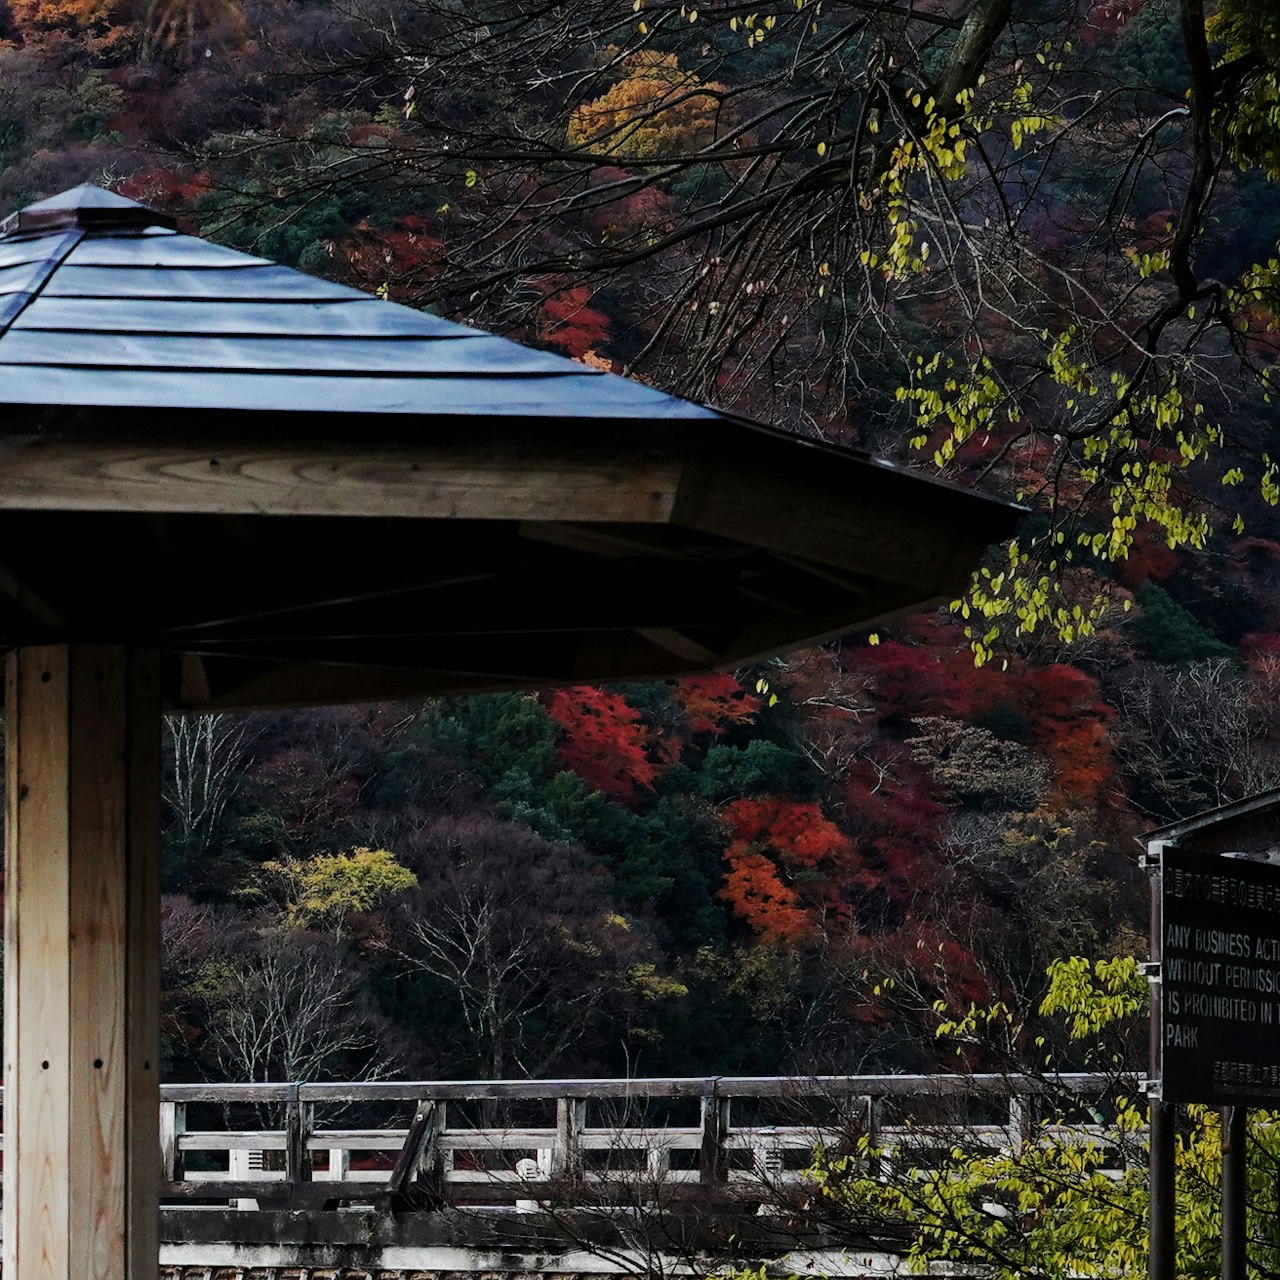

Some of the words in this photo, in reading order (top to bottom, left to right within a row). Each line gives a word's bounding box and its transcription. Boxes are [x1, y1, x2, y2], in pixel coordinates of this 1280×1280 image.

[1166, 923, 1190, 949] ANY
[1195, 928, 1251, 958] BUSINESS
[1166, 957, 1221, 986] WITHOUT
[1168, 990, 1180, 1015] IS
[1184, 993, 1257, 1022] PROHIBITED
[1260, 1001, 1272, 1024] IN
[1166, 1023, 1199, 1048] PARK
